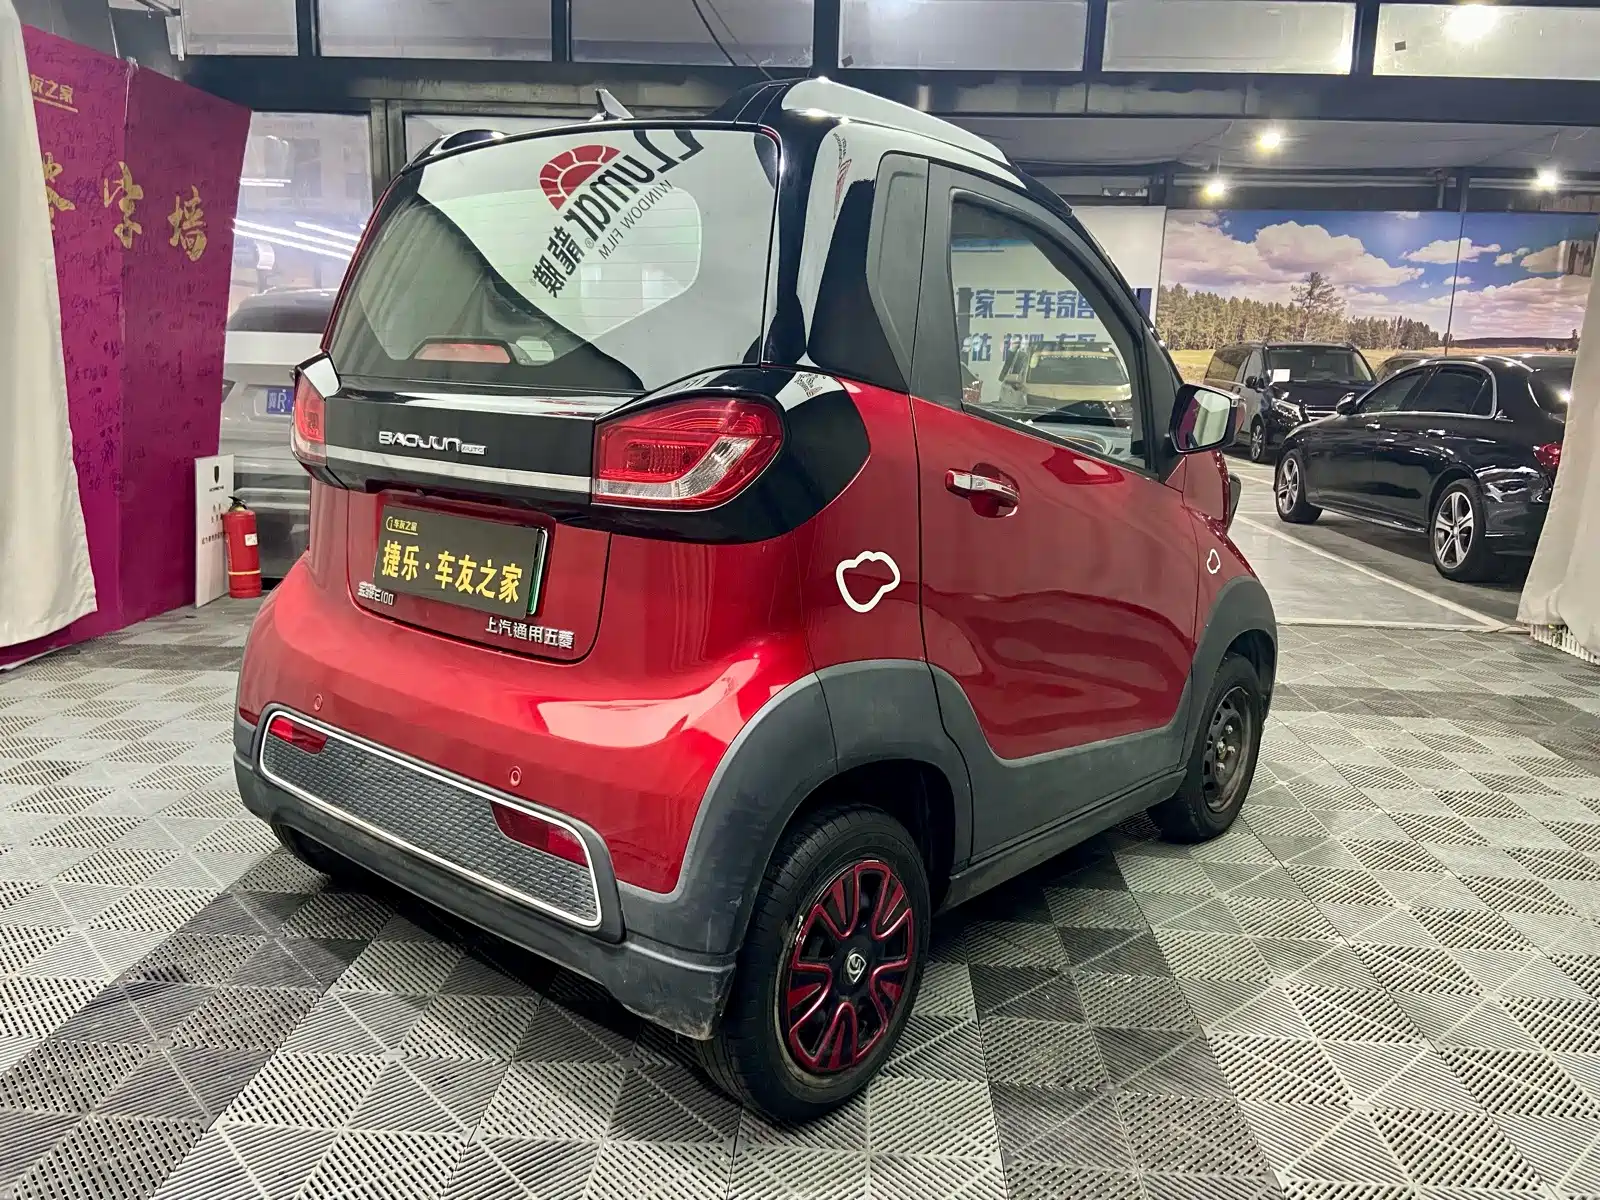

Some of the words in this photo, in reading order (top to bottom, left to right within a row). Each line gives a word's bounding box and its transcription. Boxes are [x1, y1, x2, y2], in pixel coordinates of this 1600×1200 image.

[379, 430, 462, 452] BAOJUN
[485, 617, 575, 649] 上汽通用五菱
